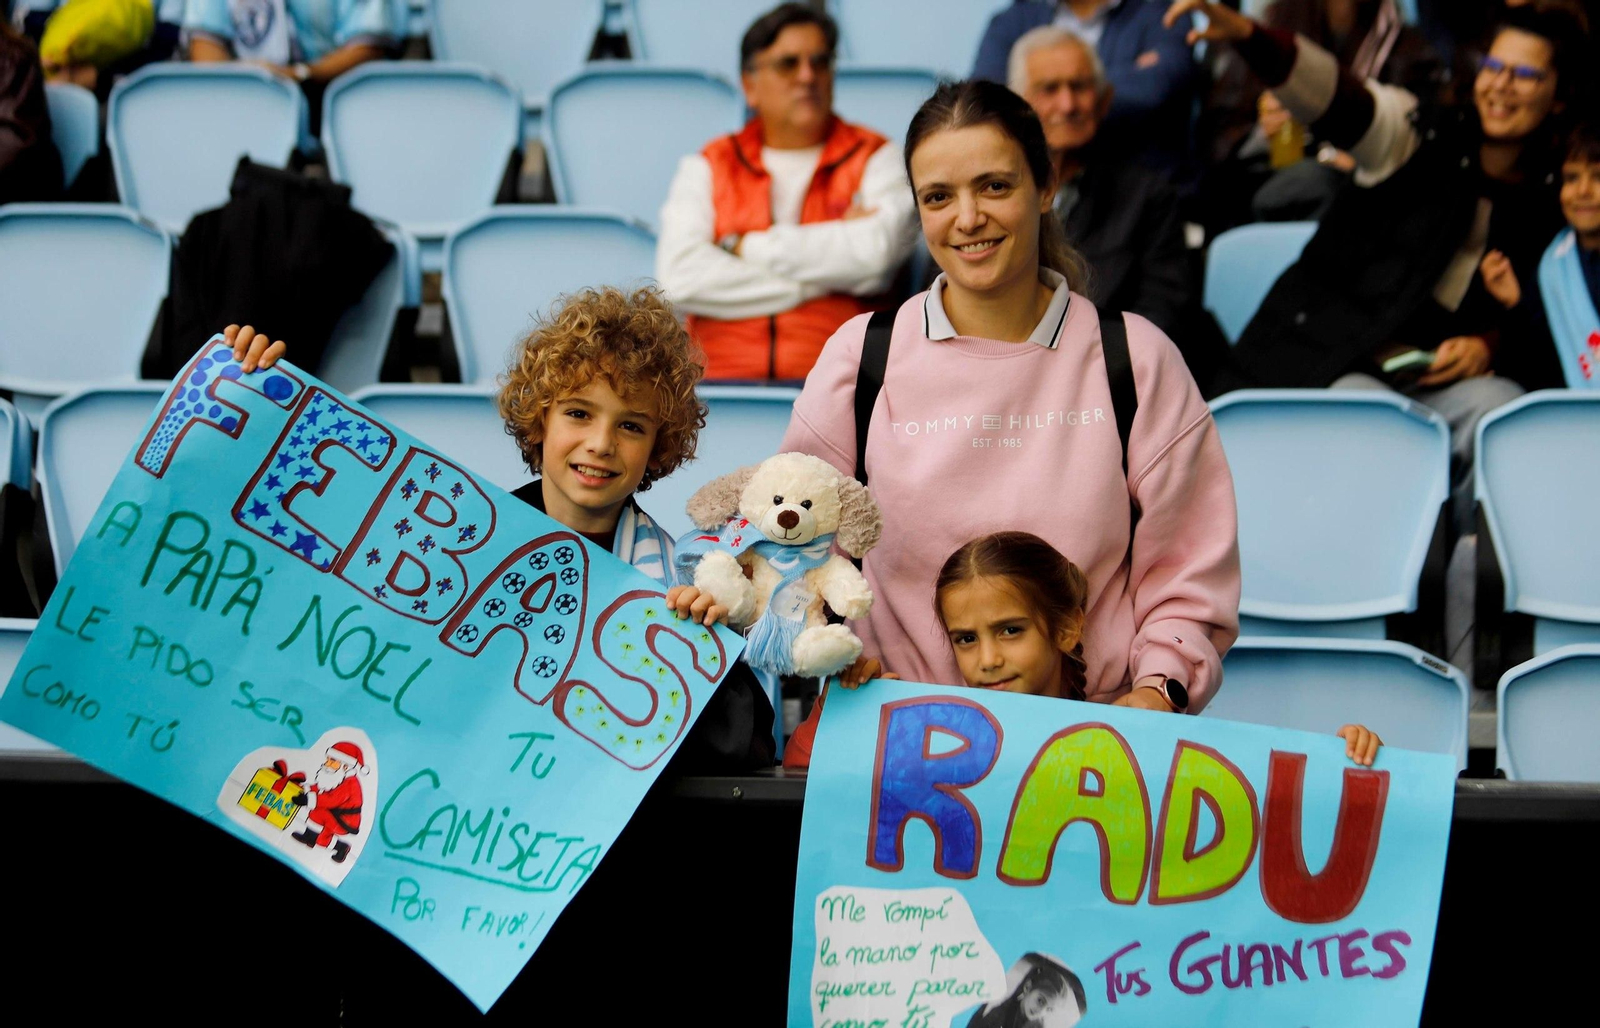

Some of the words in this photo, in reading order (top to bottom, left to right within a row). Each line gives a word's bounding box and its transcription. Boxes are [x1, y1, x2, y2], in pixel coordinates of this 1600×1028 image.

[890, 414, 975, 436] TOMMY
[1009, 407, 1107, 430] HILFIGER
[972, 437, 994, 448] EST.
[998, 437, 1023, 448] 1985
[134, 338, 728, 772] FEBAS
[96, 501, 143, 548] A
[139, 510, 275, 637] PAPÁ
[276, 594, 433, 727] NOEL
[55, 585, 110, 643] LE
[231, 681, 306, 746] SER
[22, 664, 102, 721] COMO
[508, 732, 557, 780] TU
[246, 781, 296, 819] FEBAS
[866, 695, 1391, 925] RADU
[390, 876, 436, 922] POR
[820, 894, 867, 923] Me
[883, 895, 954, 933] rompí
[819, 936, 841, 967] la
[845, 940, 923, 966] mano
[929, 940, 980, 974] por
[1093, 940, 1152, 1004] Tus
[1168, 929, 1412, 996] GUANTES
[814, 979, 897, 1013] querer
[906, 977, 990, 1007] parar
